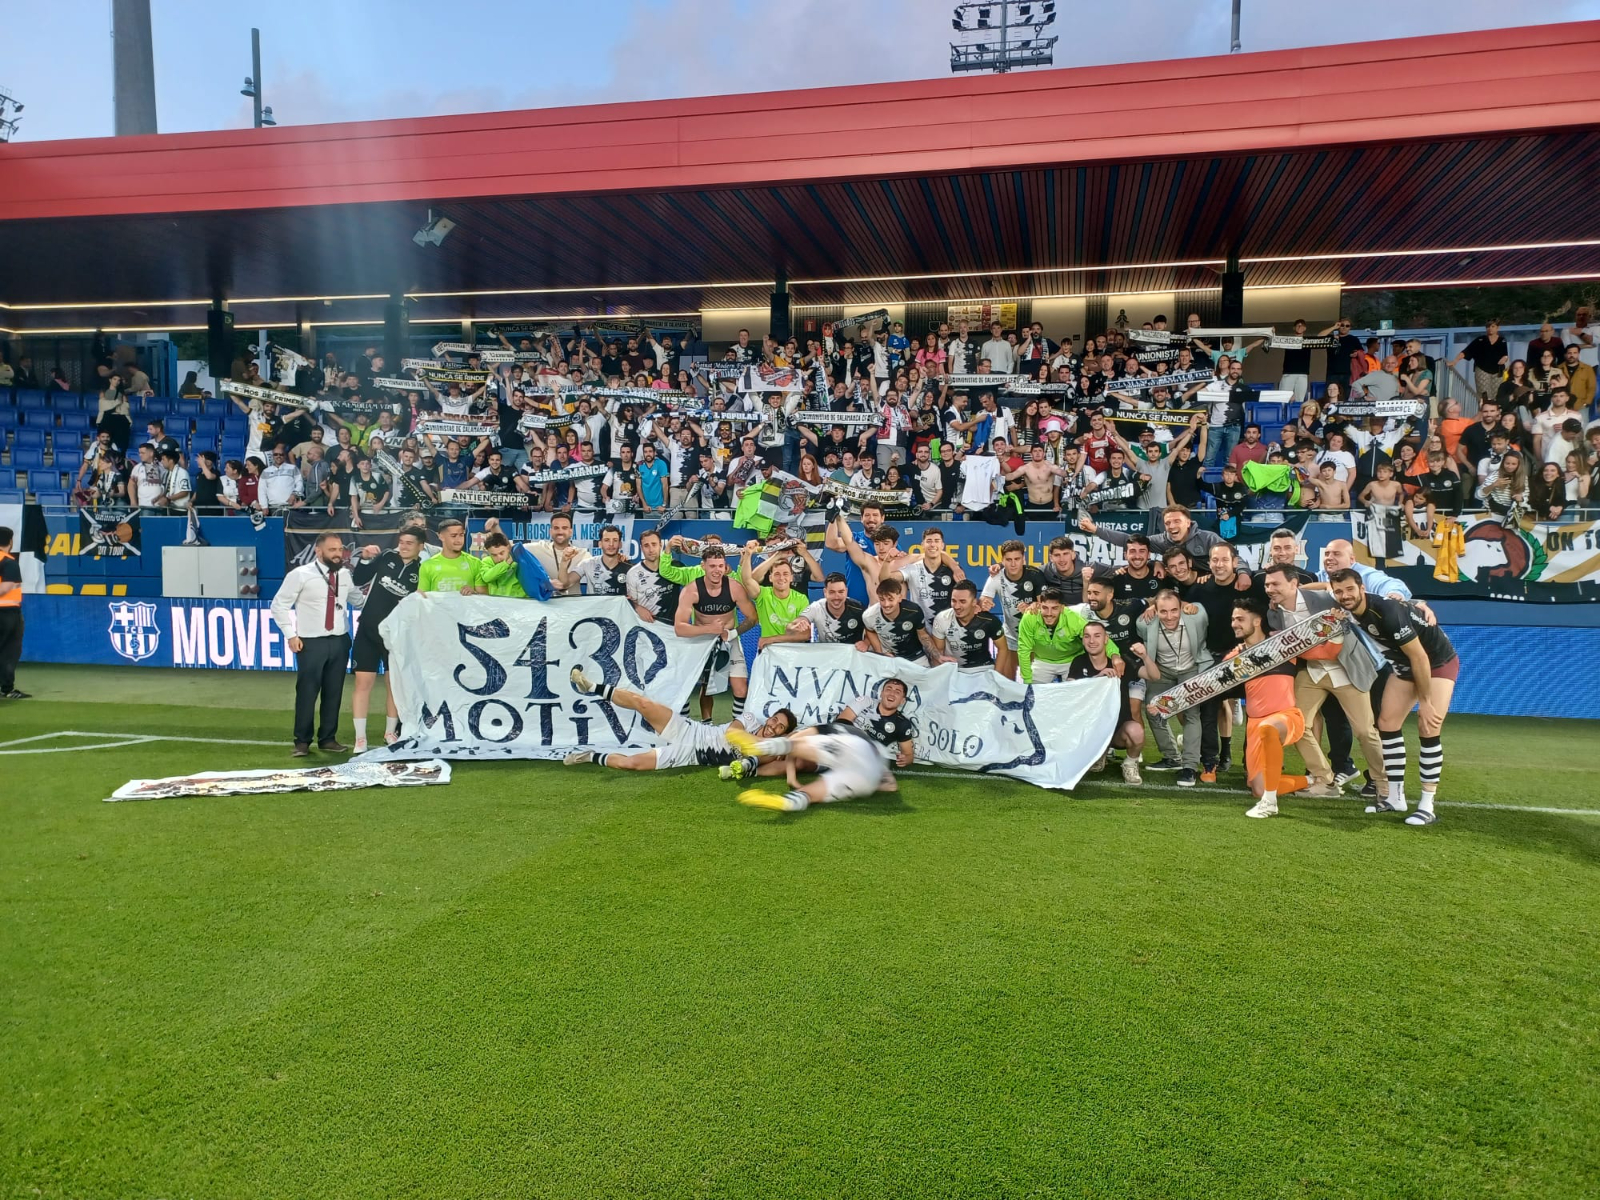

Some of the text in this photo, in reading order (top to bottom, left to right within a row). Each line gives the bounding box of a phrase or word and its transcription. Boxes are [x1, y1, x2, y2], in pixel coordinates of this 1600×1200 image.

[1136, 349, 1179, 360] UNIONISTA
[429, 371, 451, 379] NUNCA
[465, 373, 485, 381] RINDE
[1116, 411, 1147, 420] NUNCA
[1162, 415, 1189, 423] RINDE
[452, 492, 529, 503] ANTIENGENDRO
[834, 486, 856, 497] SMOS
[859, 492, 867, 500] DE
[512, 522, 524, 540] LA
[1130, 522, 1144, 531] CF
[1547, 531, 1574, 551] ON
[171, 606, 297, 667] MOVE
[1120, 630, 1129, 638] QR
[1280, 631, 1299, 647] del
[1279, 638, 1312, 659] barrio
[453, 615, 668, 699] 5430
[1185, 685, 1215, 705] grada
[927, 716, 983, 759] SOLO
